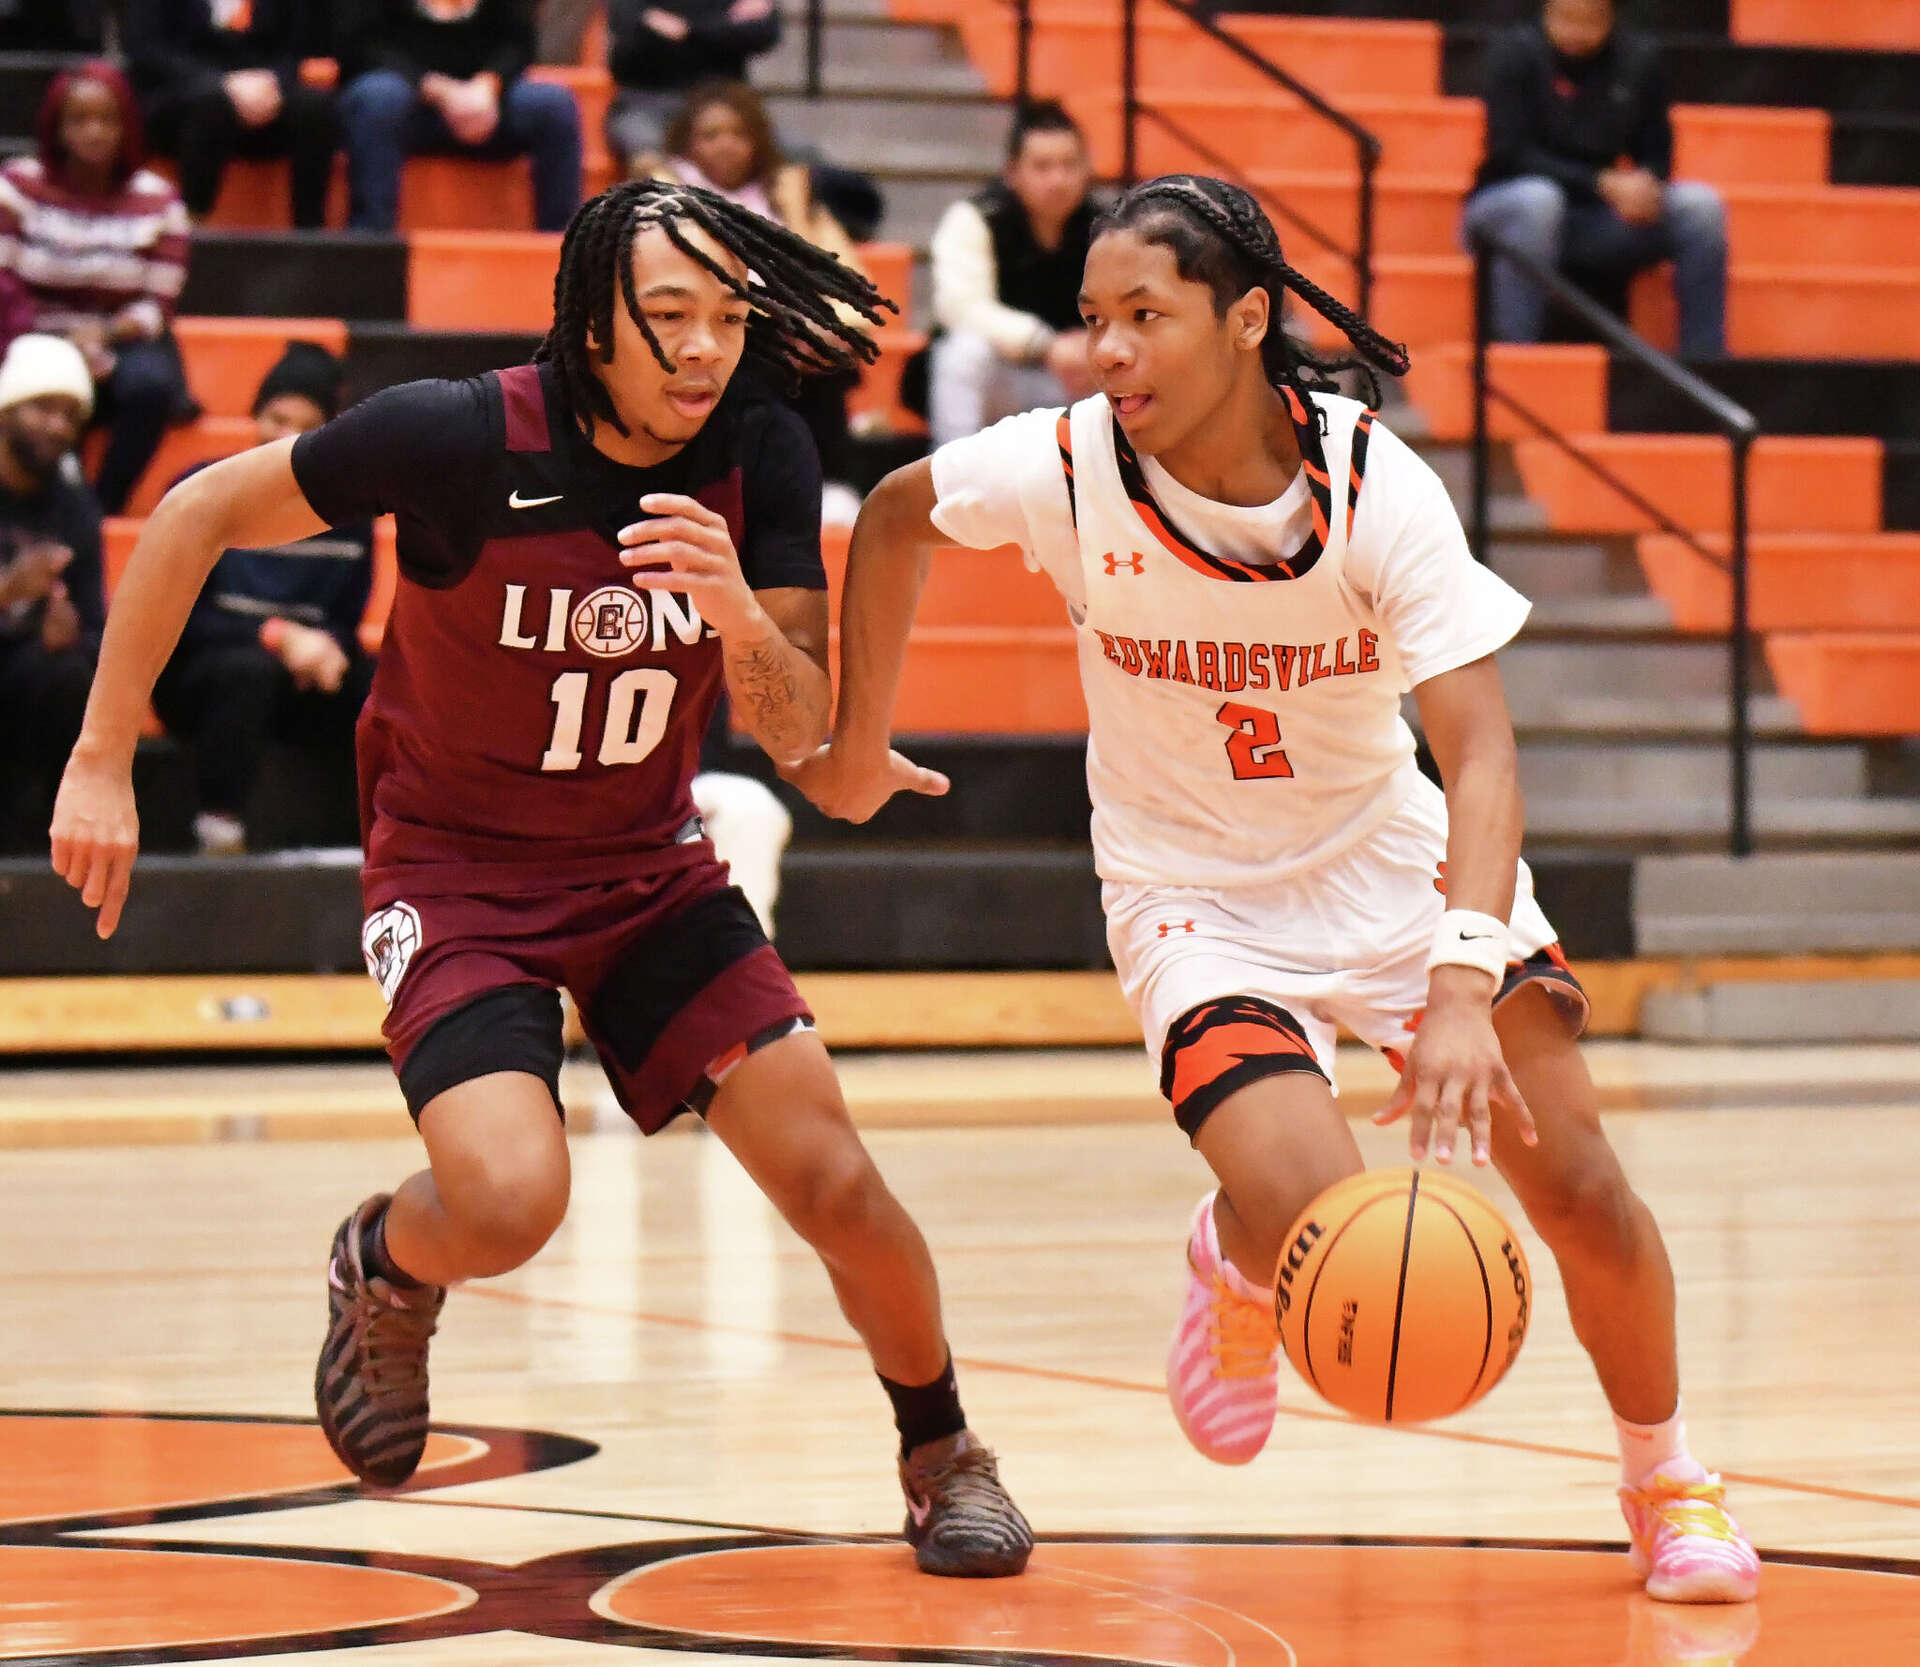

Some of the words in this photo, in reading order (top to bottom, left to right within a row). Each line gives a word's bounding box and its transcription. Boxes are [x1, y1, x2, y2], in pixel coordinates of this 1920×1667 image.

[498, 584, 720, 658] LION
[1094, 628, 1380, 692] EDWARDSVILLE
[541, 668, 678, 771] 10
[1216, 701, 1294, 780] 2
